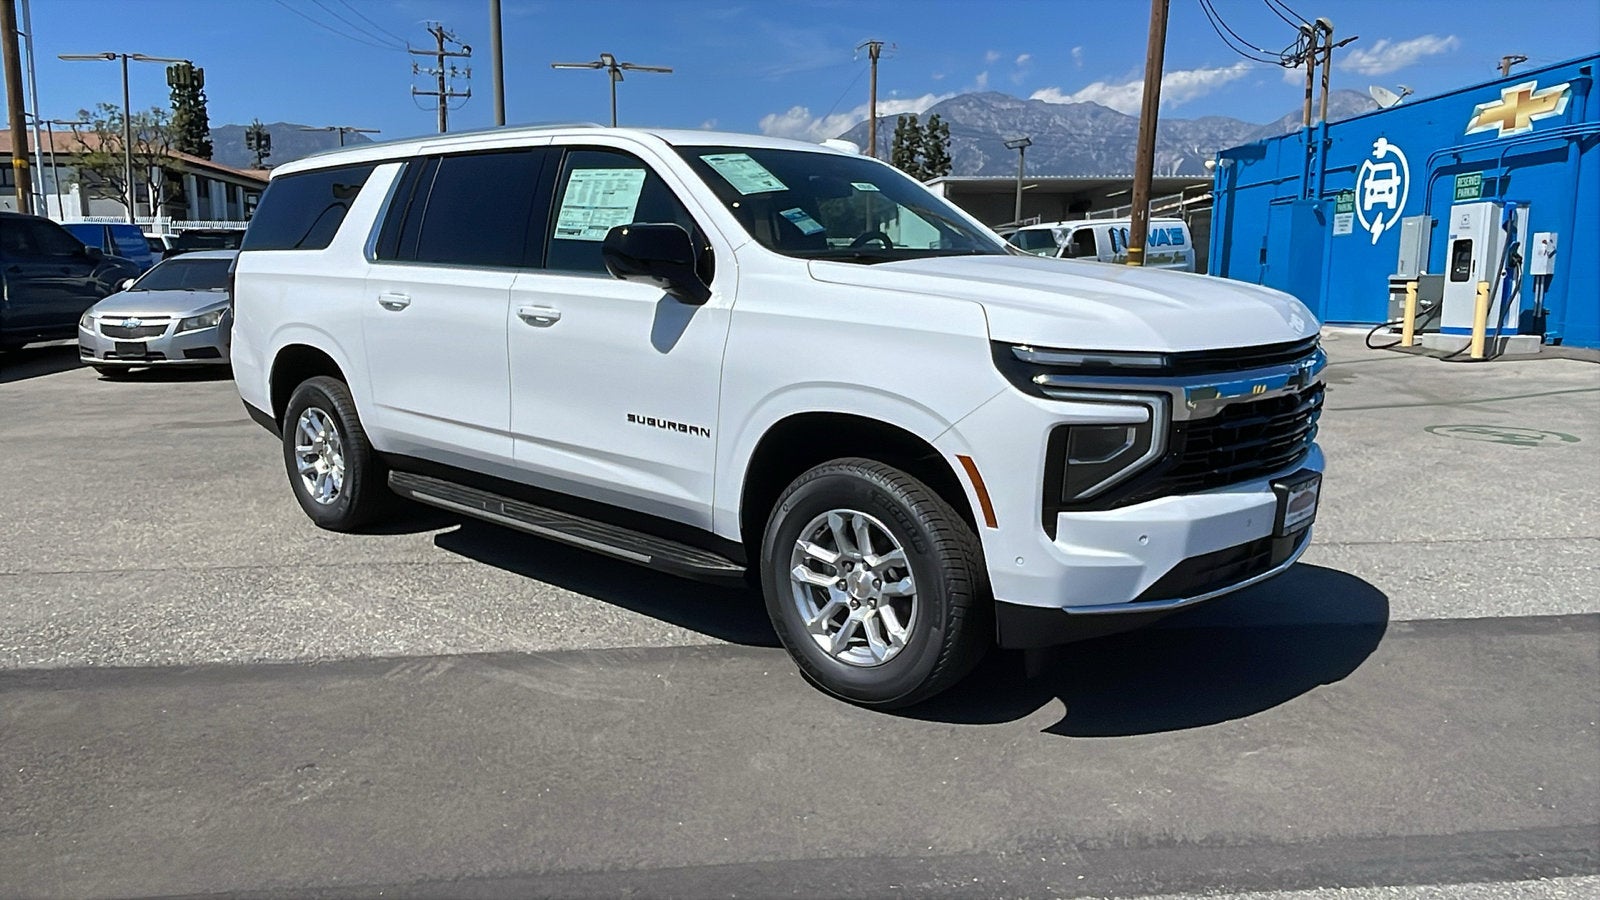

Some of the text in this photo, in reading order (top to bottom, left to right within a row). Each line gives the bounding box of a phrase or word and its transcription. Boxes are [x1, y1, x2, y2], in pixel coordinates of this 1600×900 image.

[1457, 175, 1481, 187] RESERVED
[1457, 186, 1478, 198] PARKING
[627, 413, 711, 438] SUBURBAN
